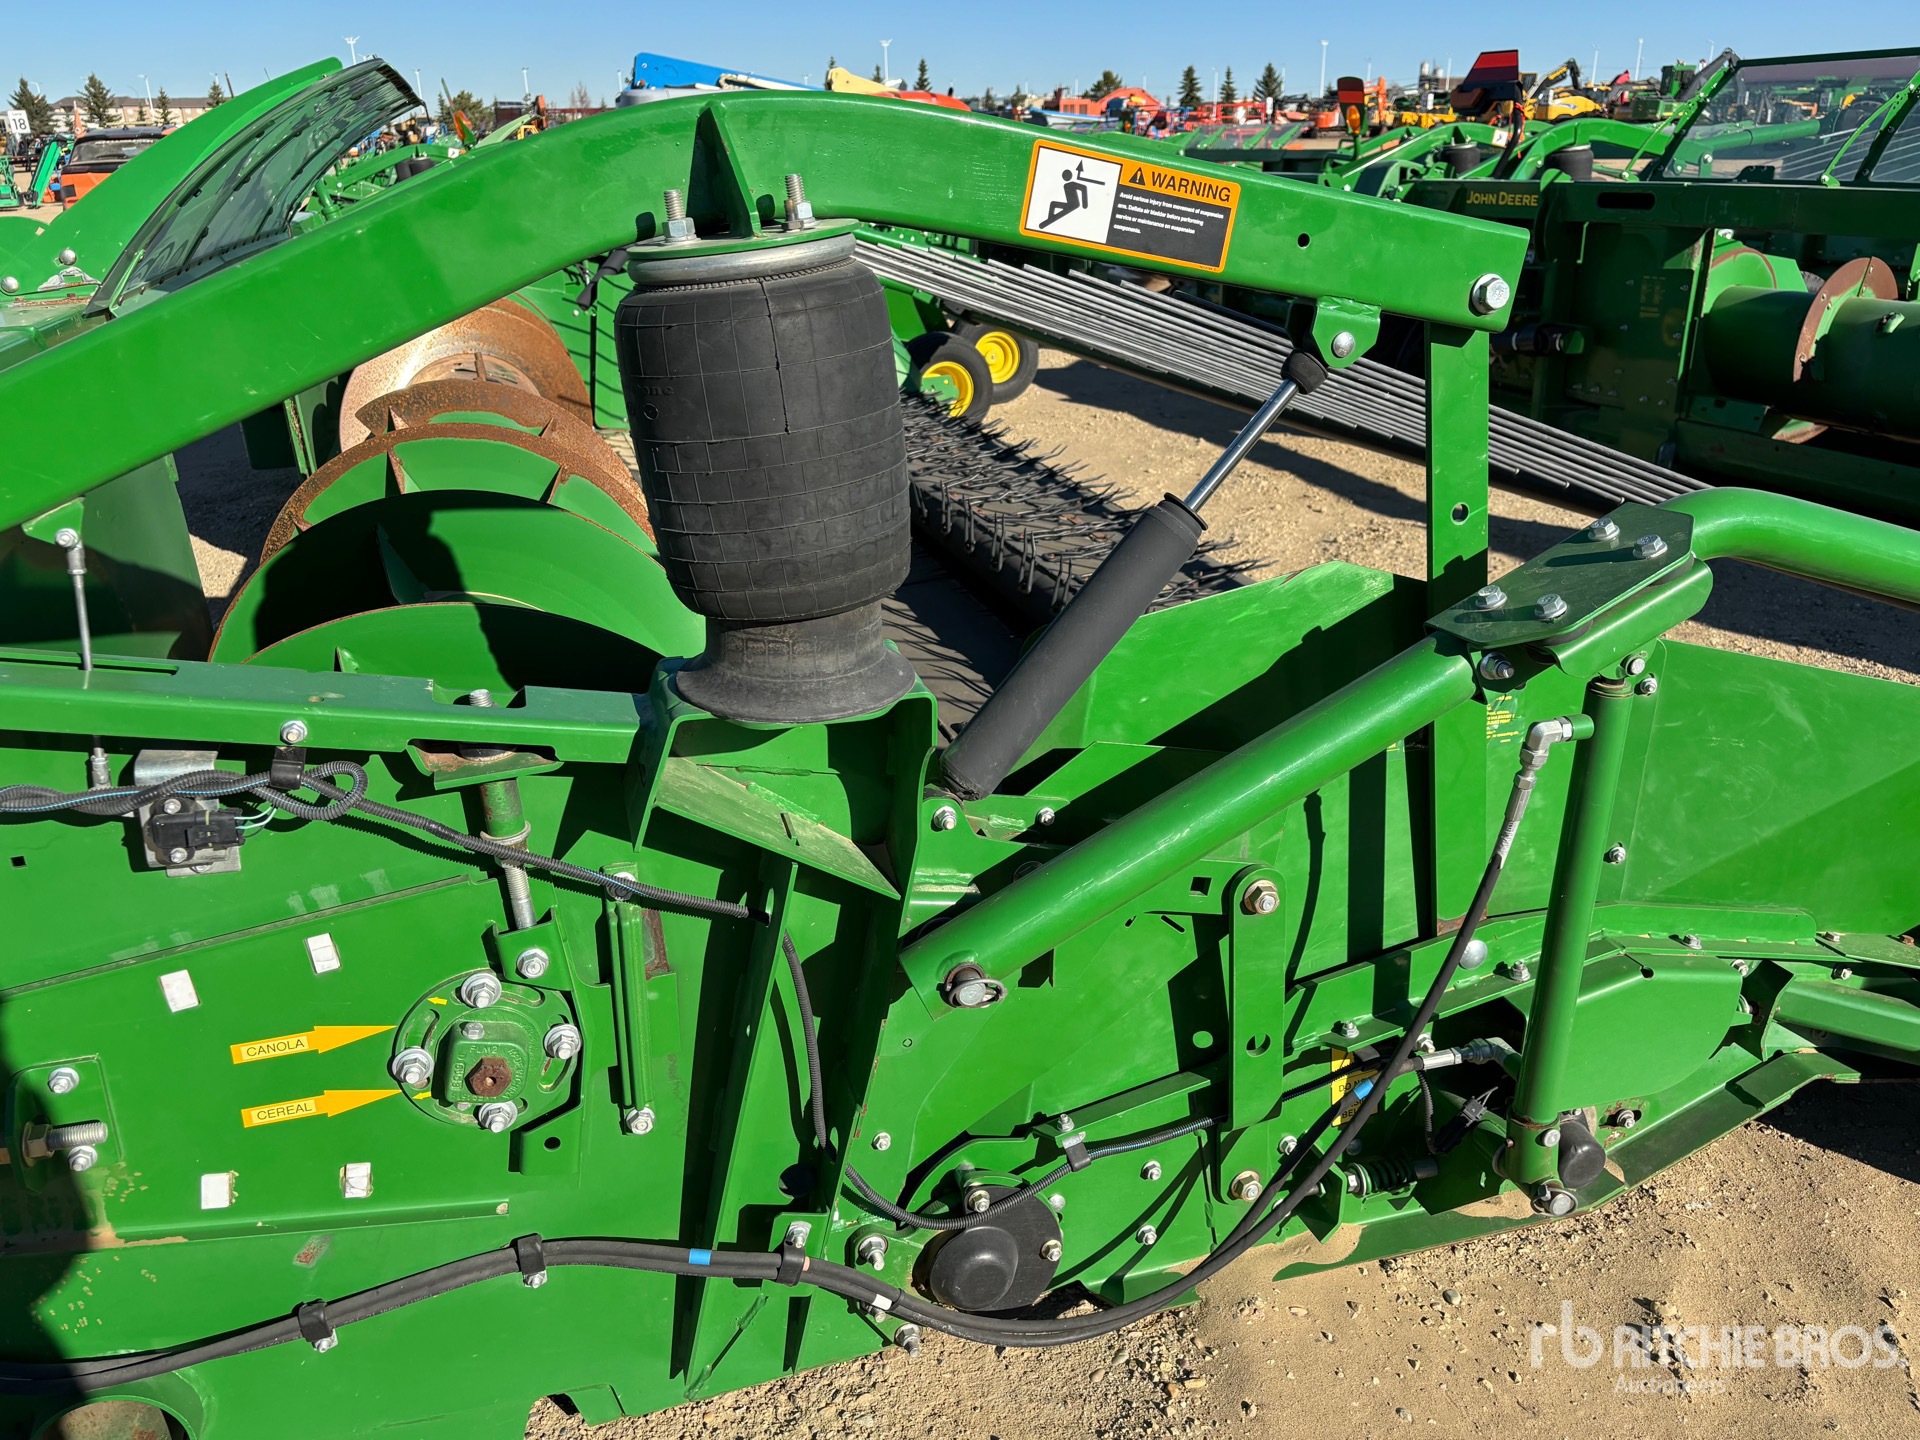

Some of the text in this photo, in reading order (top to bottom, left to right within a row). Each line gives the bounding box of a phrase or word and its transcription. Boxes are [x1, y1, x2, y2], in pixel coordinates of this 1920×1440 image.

[12, 118, 27, 130] 18
[1151, 171, 1231, 203] WARNING
[1466, 191, 1539, 206] JOHN DEERE
[246, 1038, 305, 1057] CANOLA
[1338, 1082, 1351, 1092] DO
[256, 1102, 313, 1121] CEREAL
